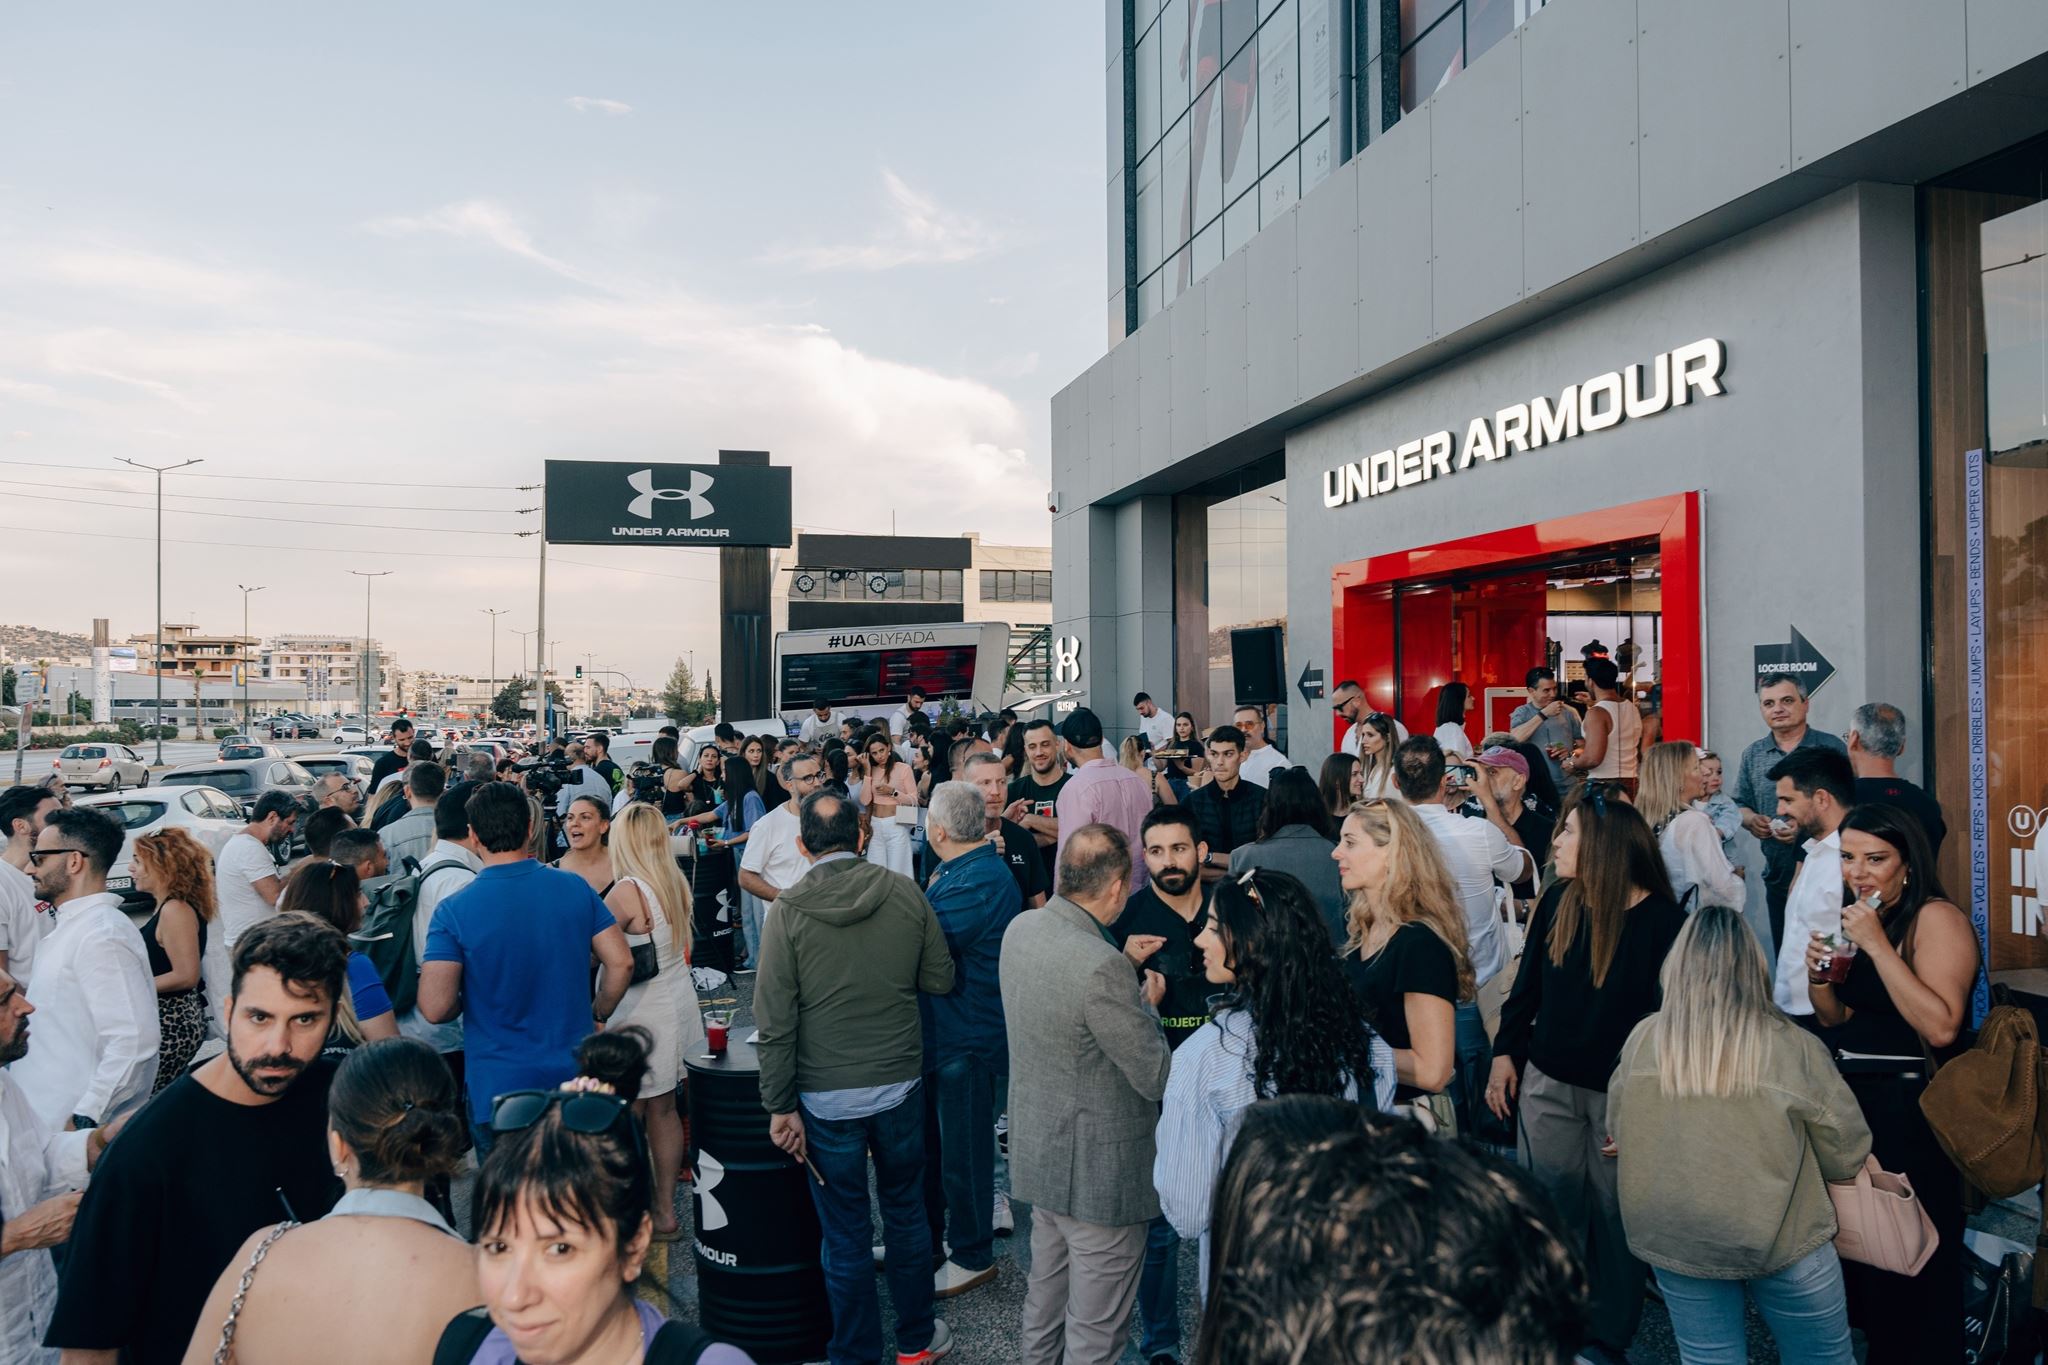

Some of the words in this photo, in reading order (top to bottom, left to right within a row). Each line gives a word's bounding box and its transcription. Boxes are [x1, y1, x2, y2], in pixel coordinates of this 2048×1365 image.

[1323, 430, 1456, 508] UNDER
[1458, 338, 1727, 470] ARMOUR
[1968, 454, 1980, 487] CUTS
[1969, 489, 1981, 529] UPPER
[612, 527, 662, 536] UNDER
[666, 528, 730, 538] ARMOUR
[1969, 538, 1981, 579] BENDS
[1970, 588, 1982, 636] LAYUPS
[828, 631, 936, 648] #UAGLYFADA
[1758, 663, 1790, 673] LOCKER
[1790, 662, 1817, 672] ROOM
[1971, 645, 1982, 688] JUMPS
[1971, 697, 1983, 754] DRIBBLES
[1972, 763, 1984, 799] KICKS
[1973, 809, 1984, 841] REPS
[1974, 850, 1986, 904] VOLLEYS
[1161, 1016, 1202, 1028] ROJECT
